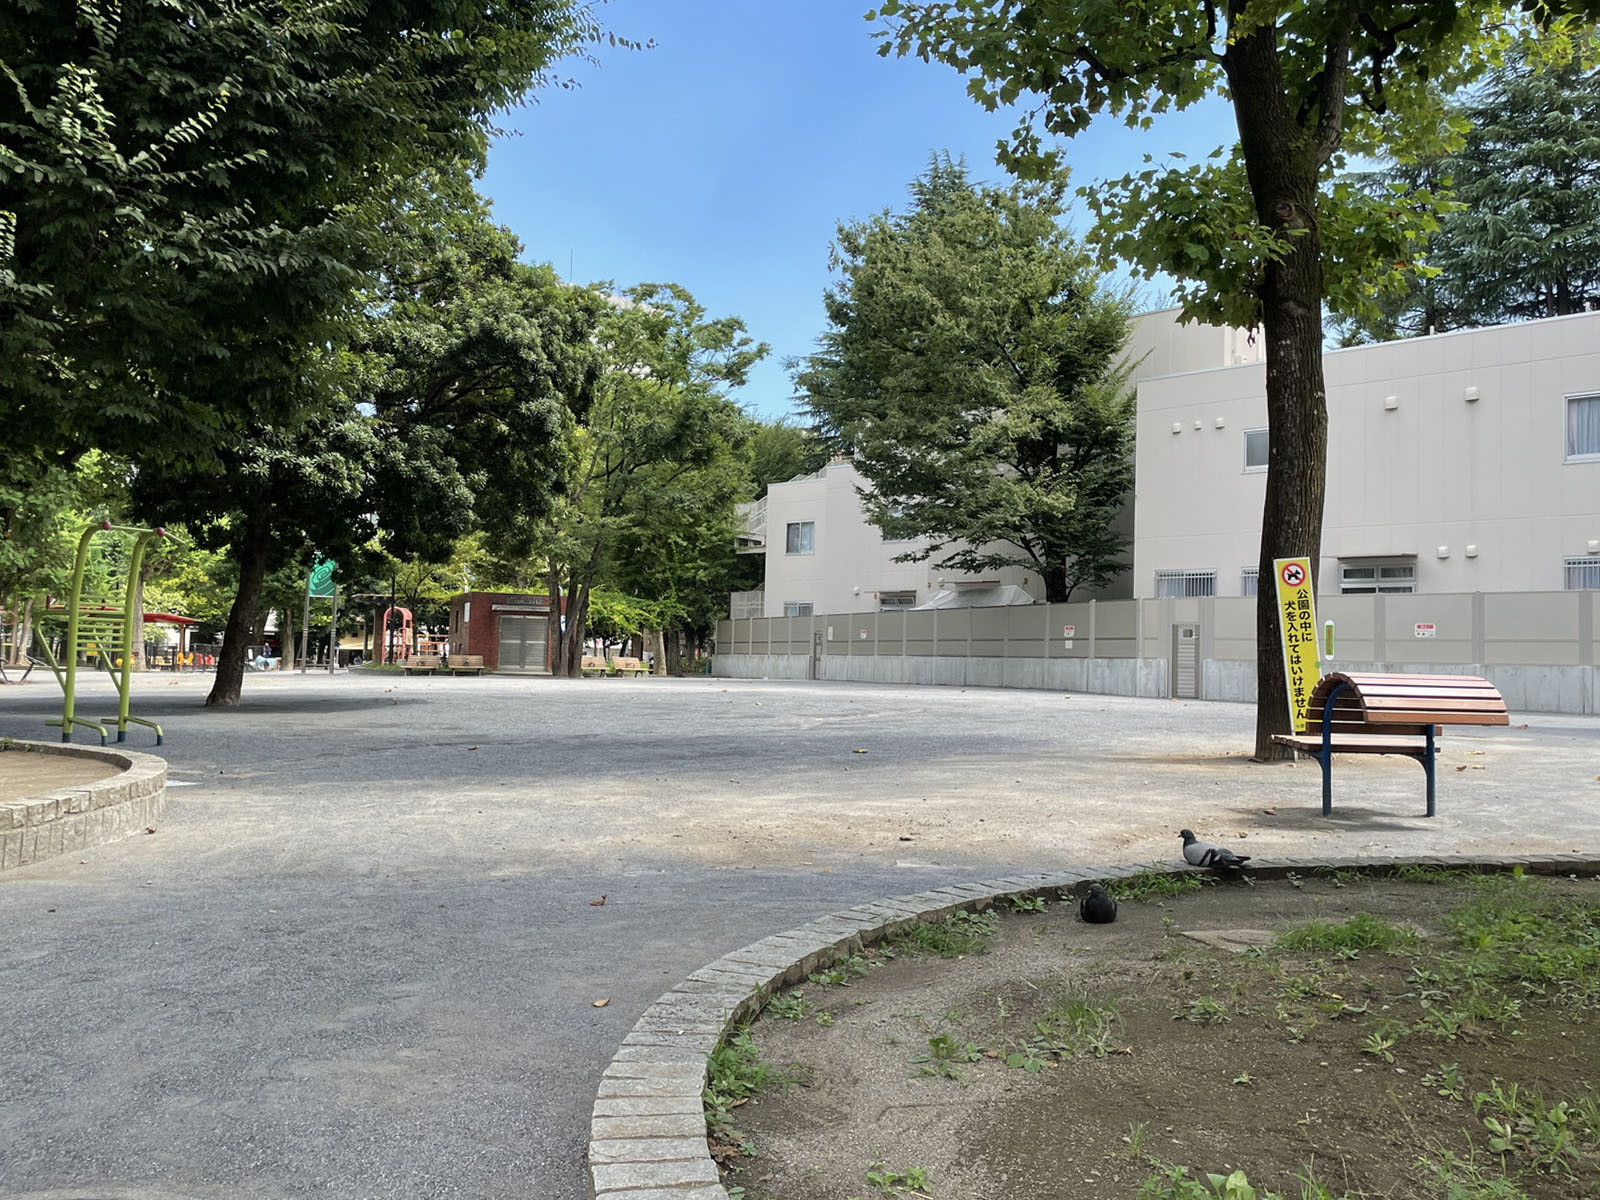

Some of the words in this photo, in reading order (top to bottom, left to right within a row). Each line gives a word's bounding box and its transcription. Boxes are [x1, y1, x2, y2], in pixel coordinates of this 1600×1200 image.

[1297, 589, 1312, 642] 公園の中に
[1284, 600, 1306, 719] 犬を入れてはいけません
